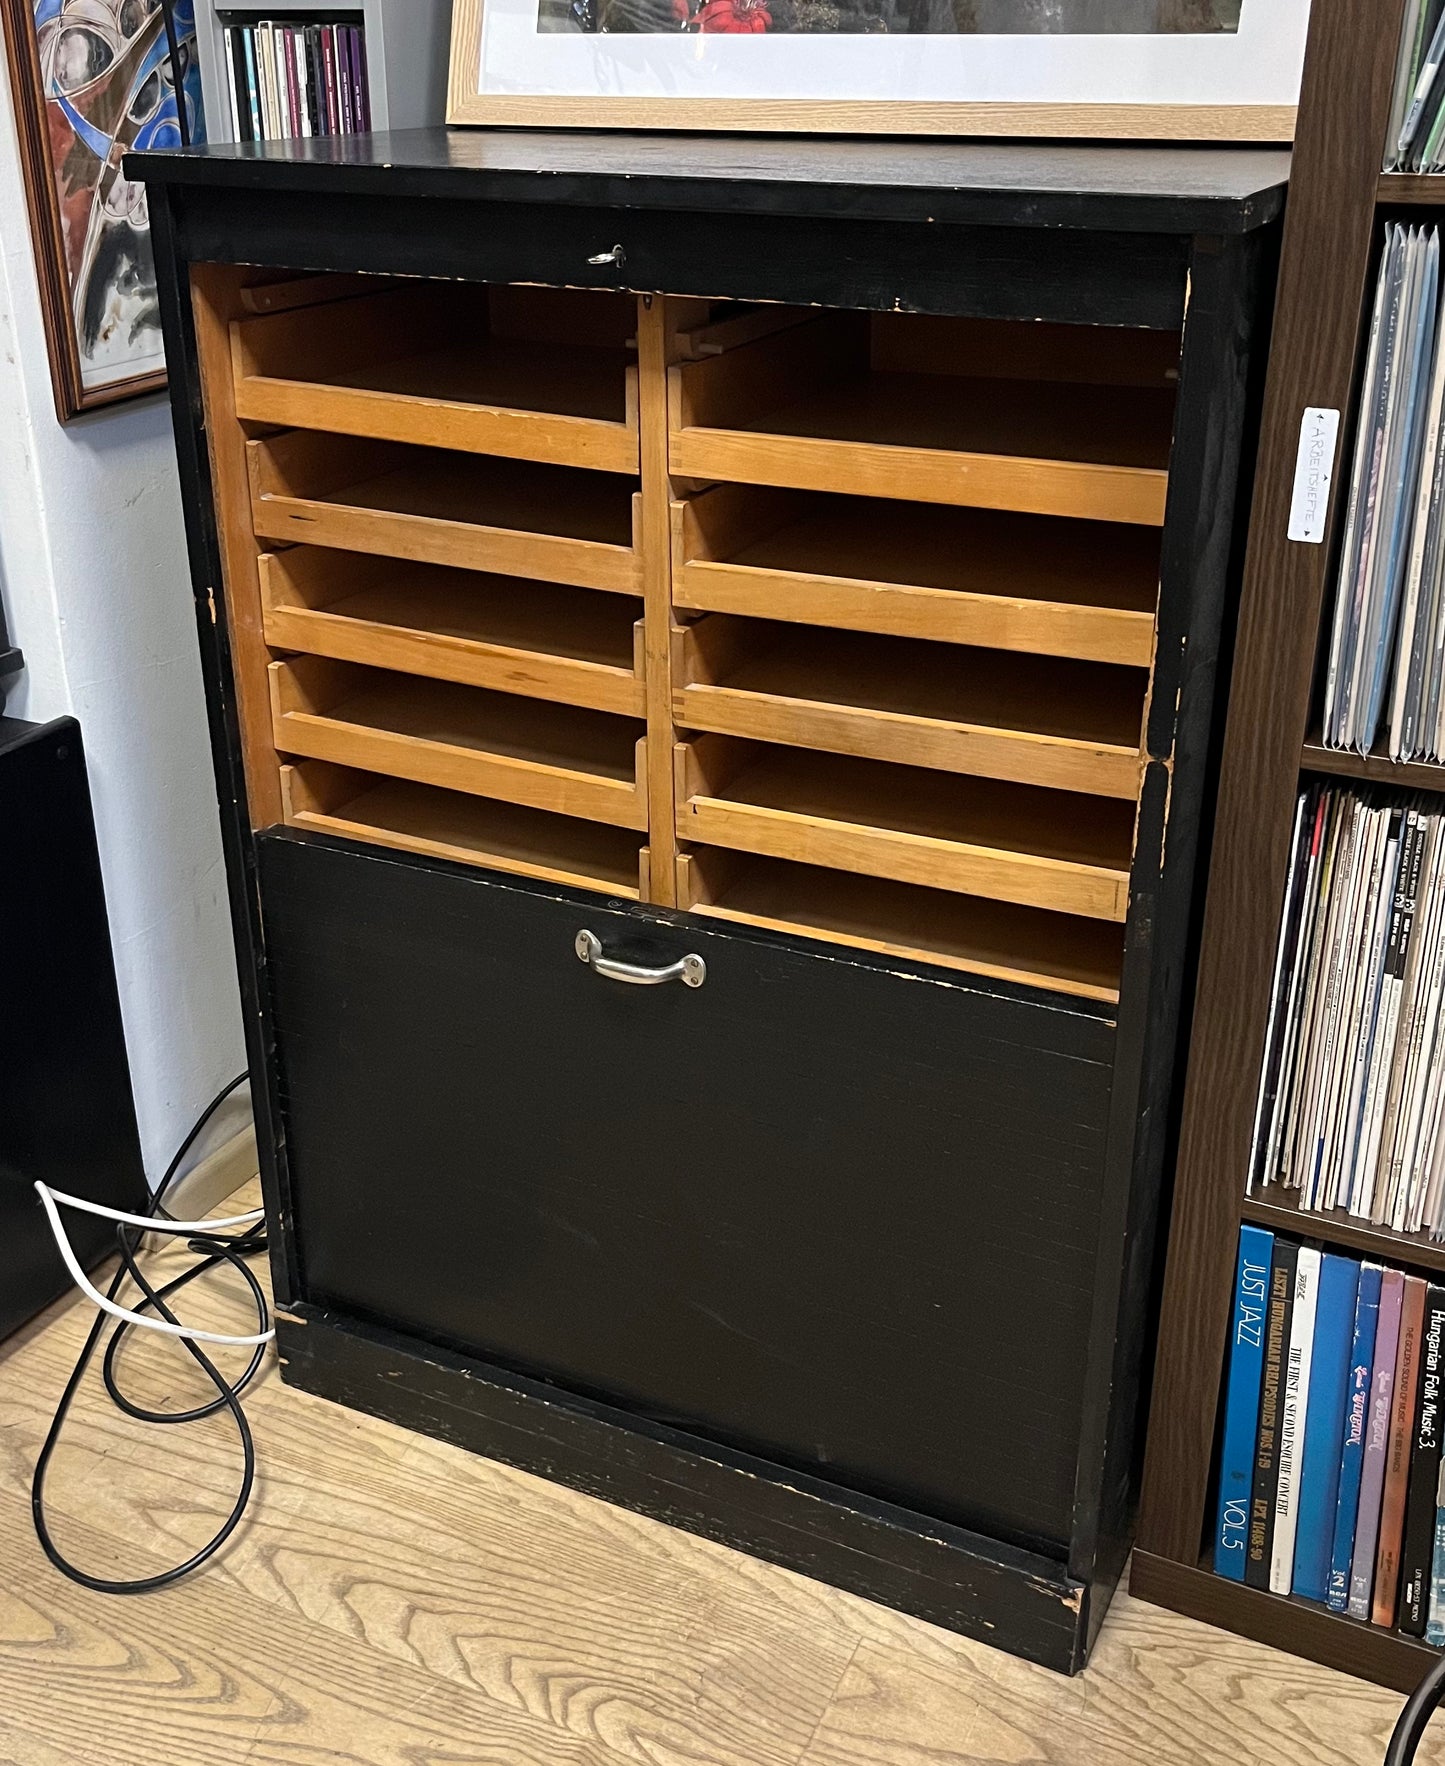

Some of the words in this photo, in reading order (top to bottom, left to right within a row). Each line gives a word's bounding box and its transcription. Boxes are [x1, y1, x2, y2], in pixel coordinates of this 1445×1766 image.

[1304, 427, 1325, 522] ARBEITSHEFTE
[1241, 1259, 1266, 1301] JUST
[1273, 1267, 1288, 1298] LISZT
[1237, 1301, 1261, 1348] JAZZ
[1267, 1301, 1285, 1363] HUNGARIAN
[1424, 1309, 1445, 1371] Hungarian
[1290, 1348, 1302, 1364] THE
[1403, 1340, 1412, 1367] GOLDEN
[1287, 1366, 1300, 1393] FIRST
[1400, 1368, 1409, 1391] SOUND
[1423, 1374, 1439, 1399] Folk
[1262, 1364, 1280, 1427] RHAPSODIES
[1283, 1403, 1297, 1437] SECOND
[1420, 1401, 1437, 1436] Music
[1261, 1428, 1274, 1449] NOS.
[1418, 1436, 1436, 1449] 3.
[1258, 1452, 1273, 1468] 1-19
[1280, 1439, 1294, 1475] ESQUIRE
[1254, 1499, 1267, 1519] LPX
[1277, 1477, 1291, 1516] CONCERT
[1250, 1521, 1266, 1560] 11488-90
[1332, 1576, 1344, 1587] 2
[1411, 1603, 1419, 1621] MONO
